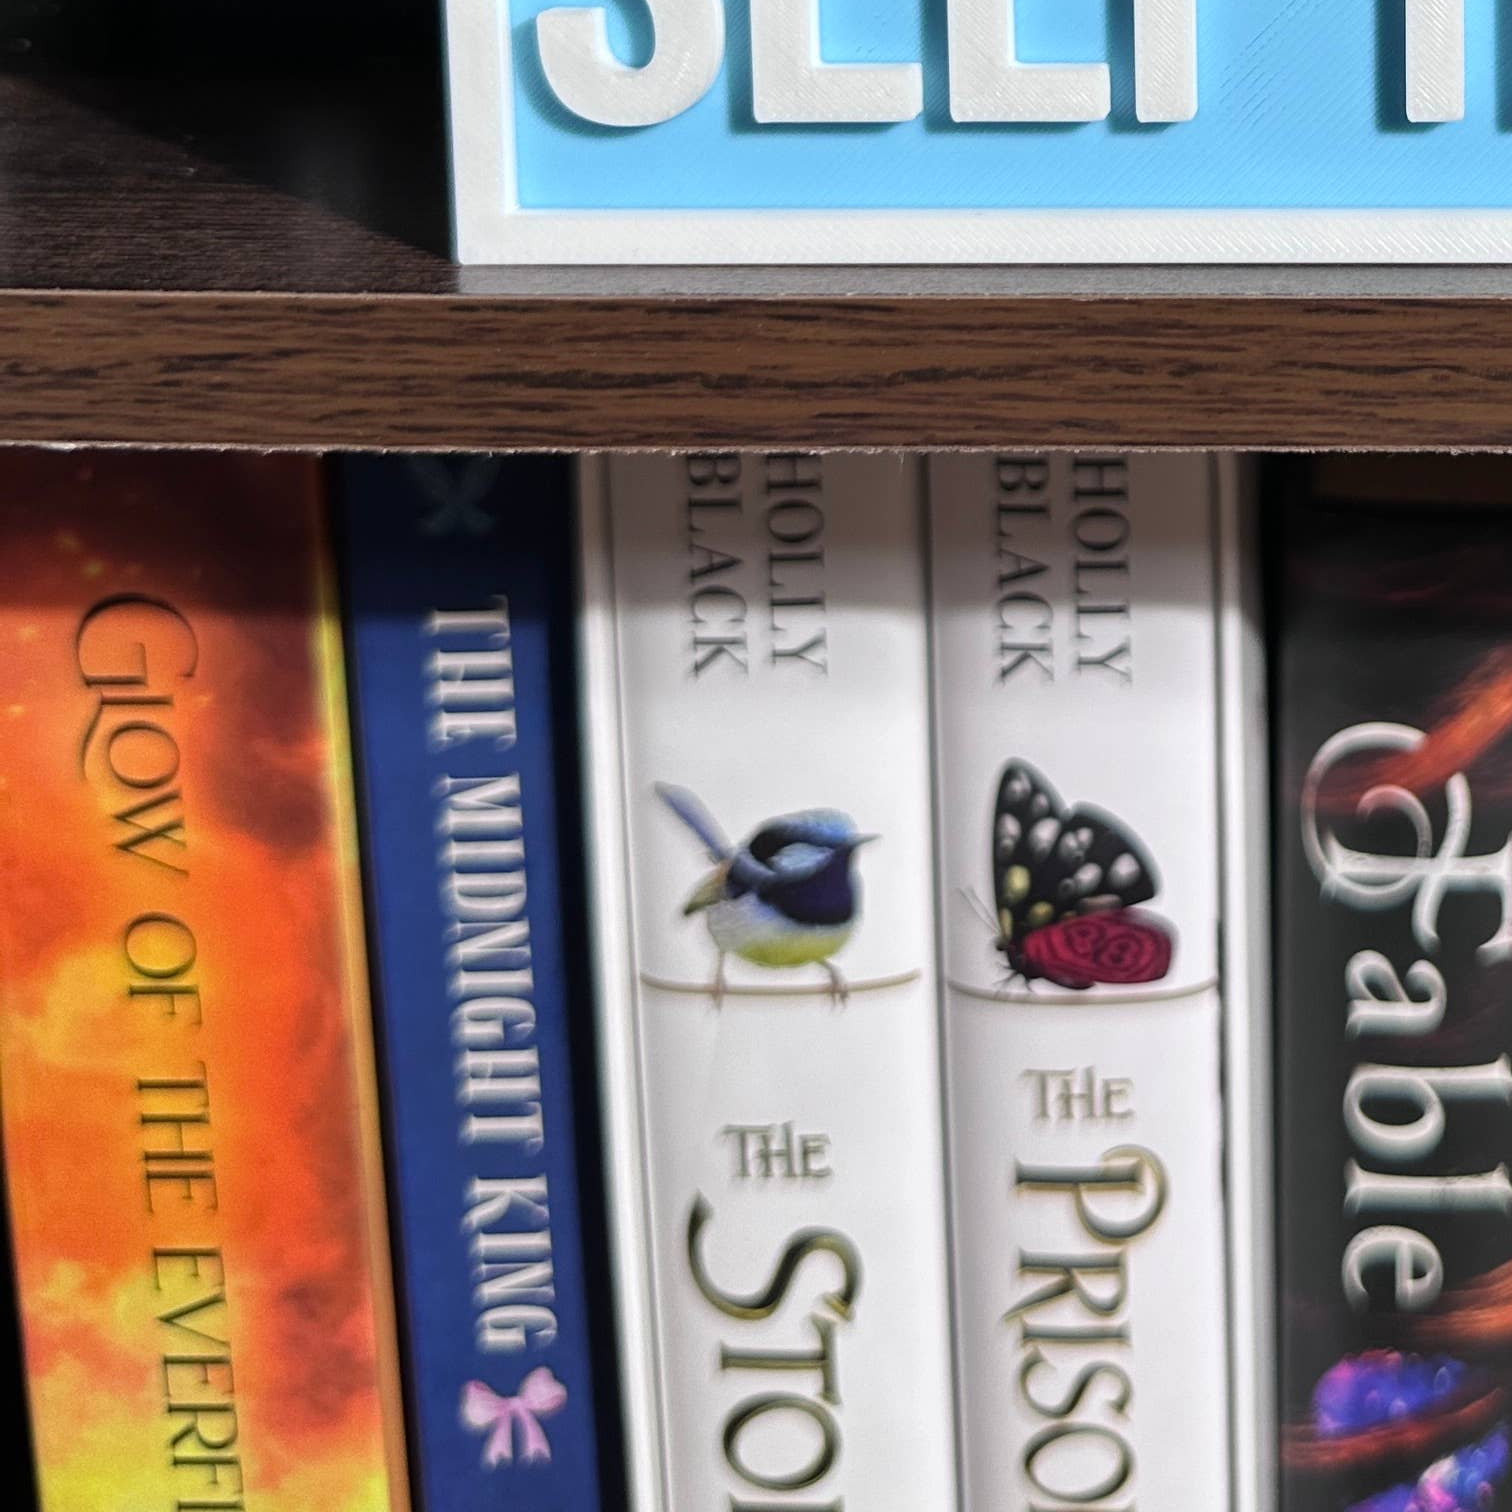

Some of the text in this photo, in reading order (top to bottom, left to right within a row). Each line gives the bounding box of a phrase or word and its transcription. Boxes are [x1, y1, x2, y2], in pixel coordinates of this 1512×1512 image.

[684, 452, 751, 679] BLACK
[764, 452, 829, 679] HOLLY
[994, 454, 1056, 687] BLACK
[1071, 454, 1133, 688] HOLLY
[73, 592, 199, 882] GLOW
[122, 911, 204, 1026] OF
[420, 593, 559, 1355] THE MIDNIGHT KING
[135, 1060, 219, 1218] THE
[719, 1119, 833, 1182] THE
[1017, 1065, 1138, 1122] THE
[686, 1186, 863, 1512] STO
[1000, 1142, 1171, 1512] PRISO
